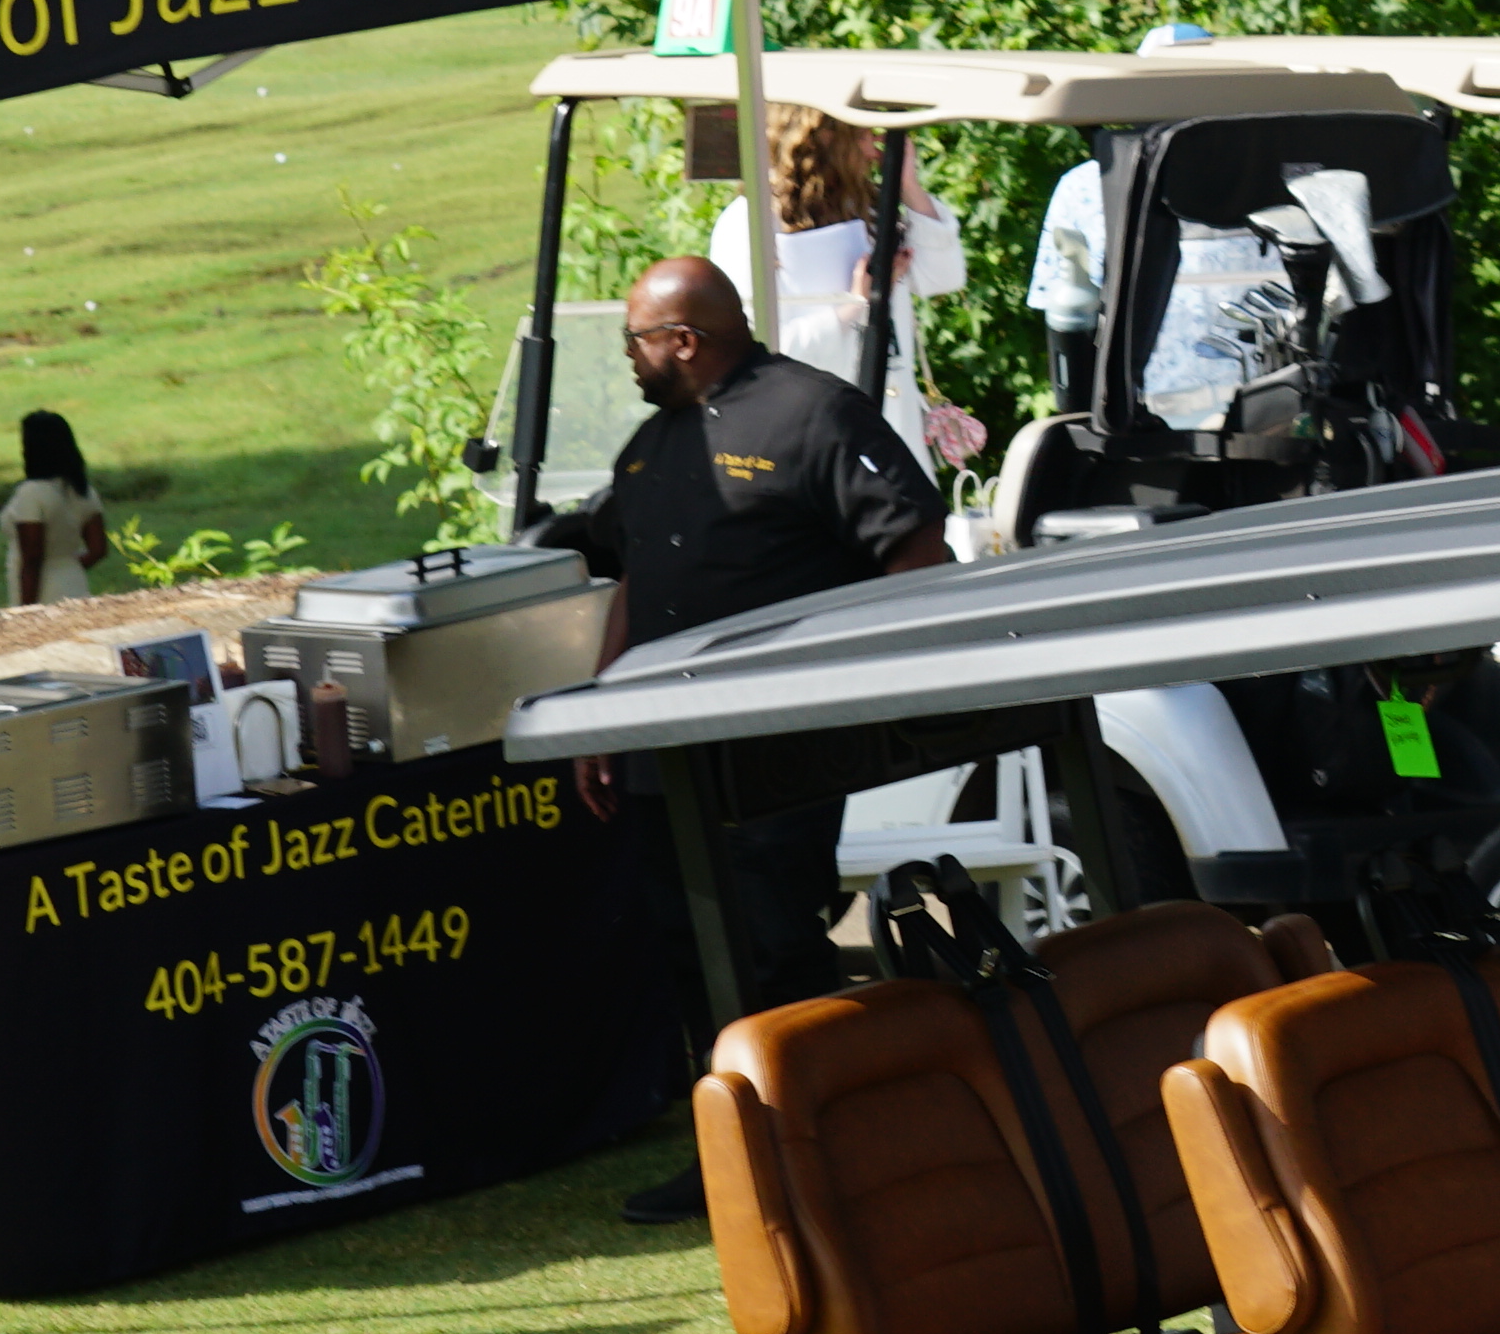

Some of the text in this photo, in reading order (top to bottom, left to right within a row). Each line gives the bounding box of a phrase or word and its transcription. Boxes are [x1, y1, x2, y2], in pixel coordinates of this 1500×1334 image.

[25, 776, 562, 934] A Taste of Jazz Catering
[143, 905, 470, 1021] 404-587-1449
